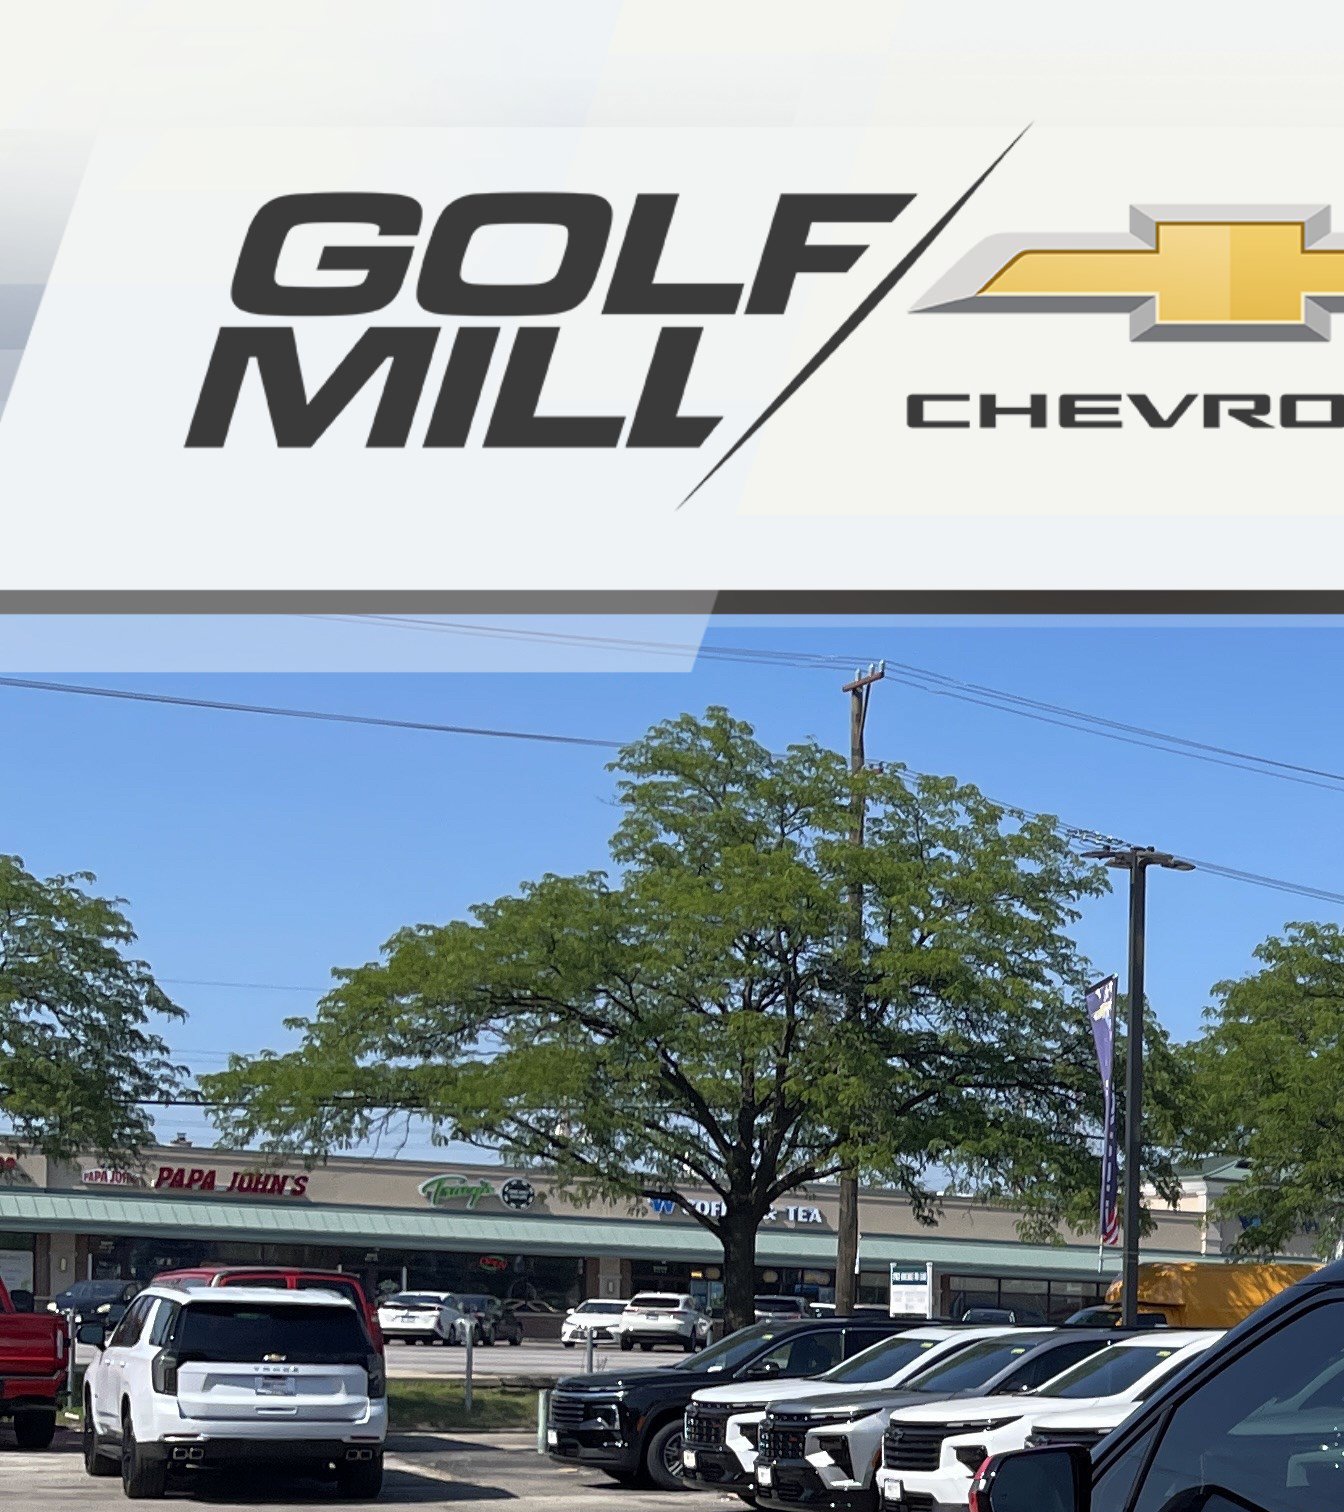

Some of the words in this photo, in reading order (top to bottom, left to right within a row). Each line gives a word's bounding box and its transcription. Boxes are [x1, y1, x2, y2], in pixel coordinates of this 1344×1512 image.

[155, 1166, 217, 1191] PAPA
[226, 1170, 309, 1197] JOHN'S
[785, 1205, 822, 1223] TEA
